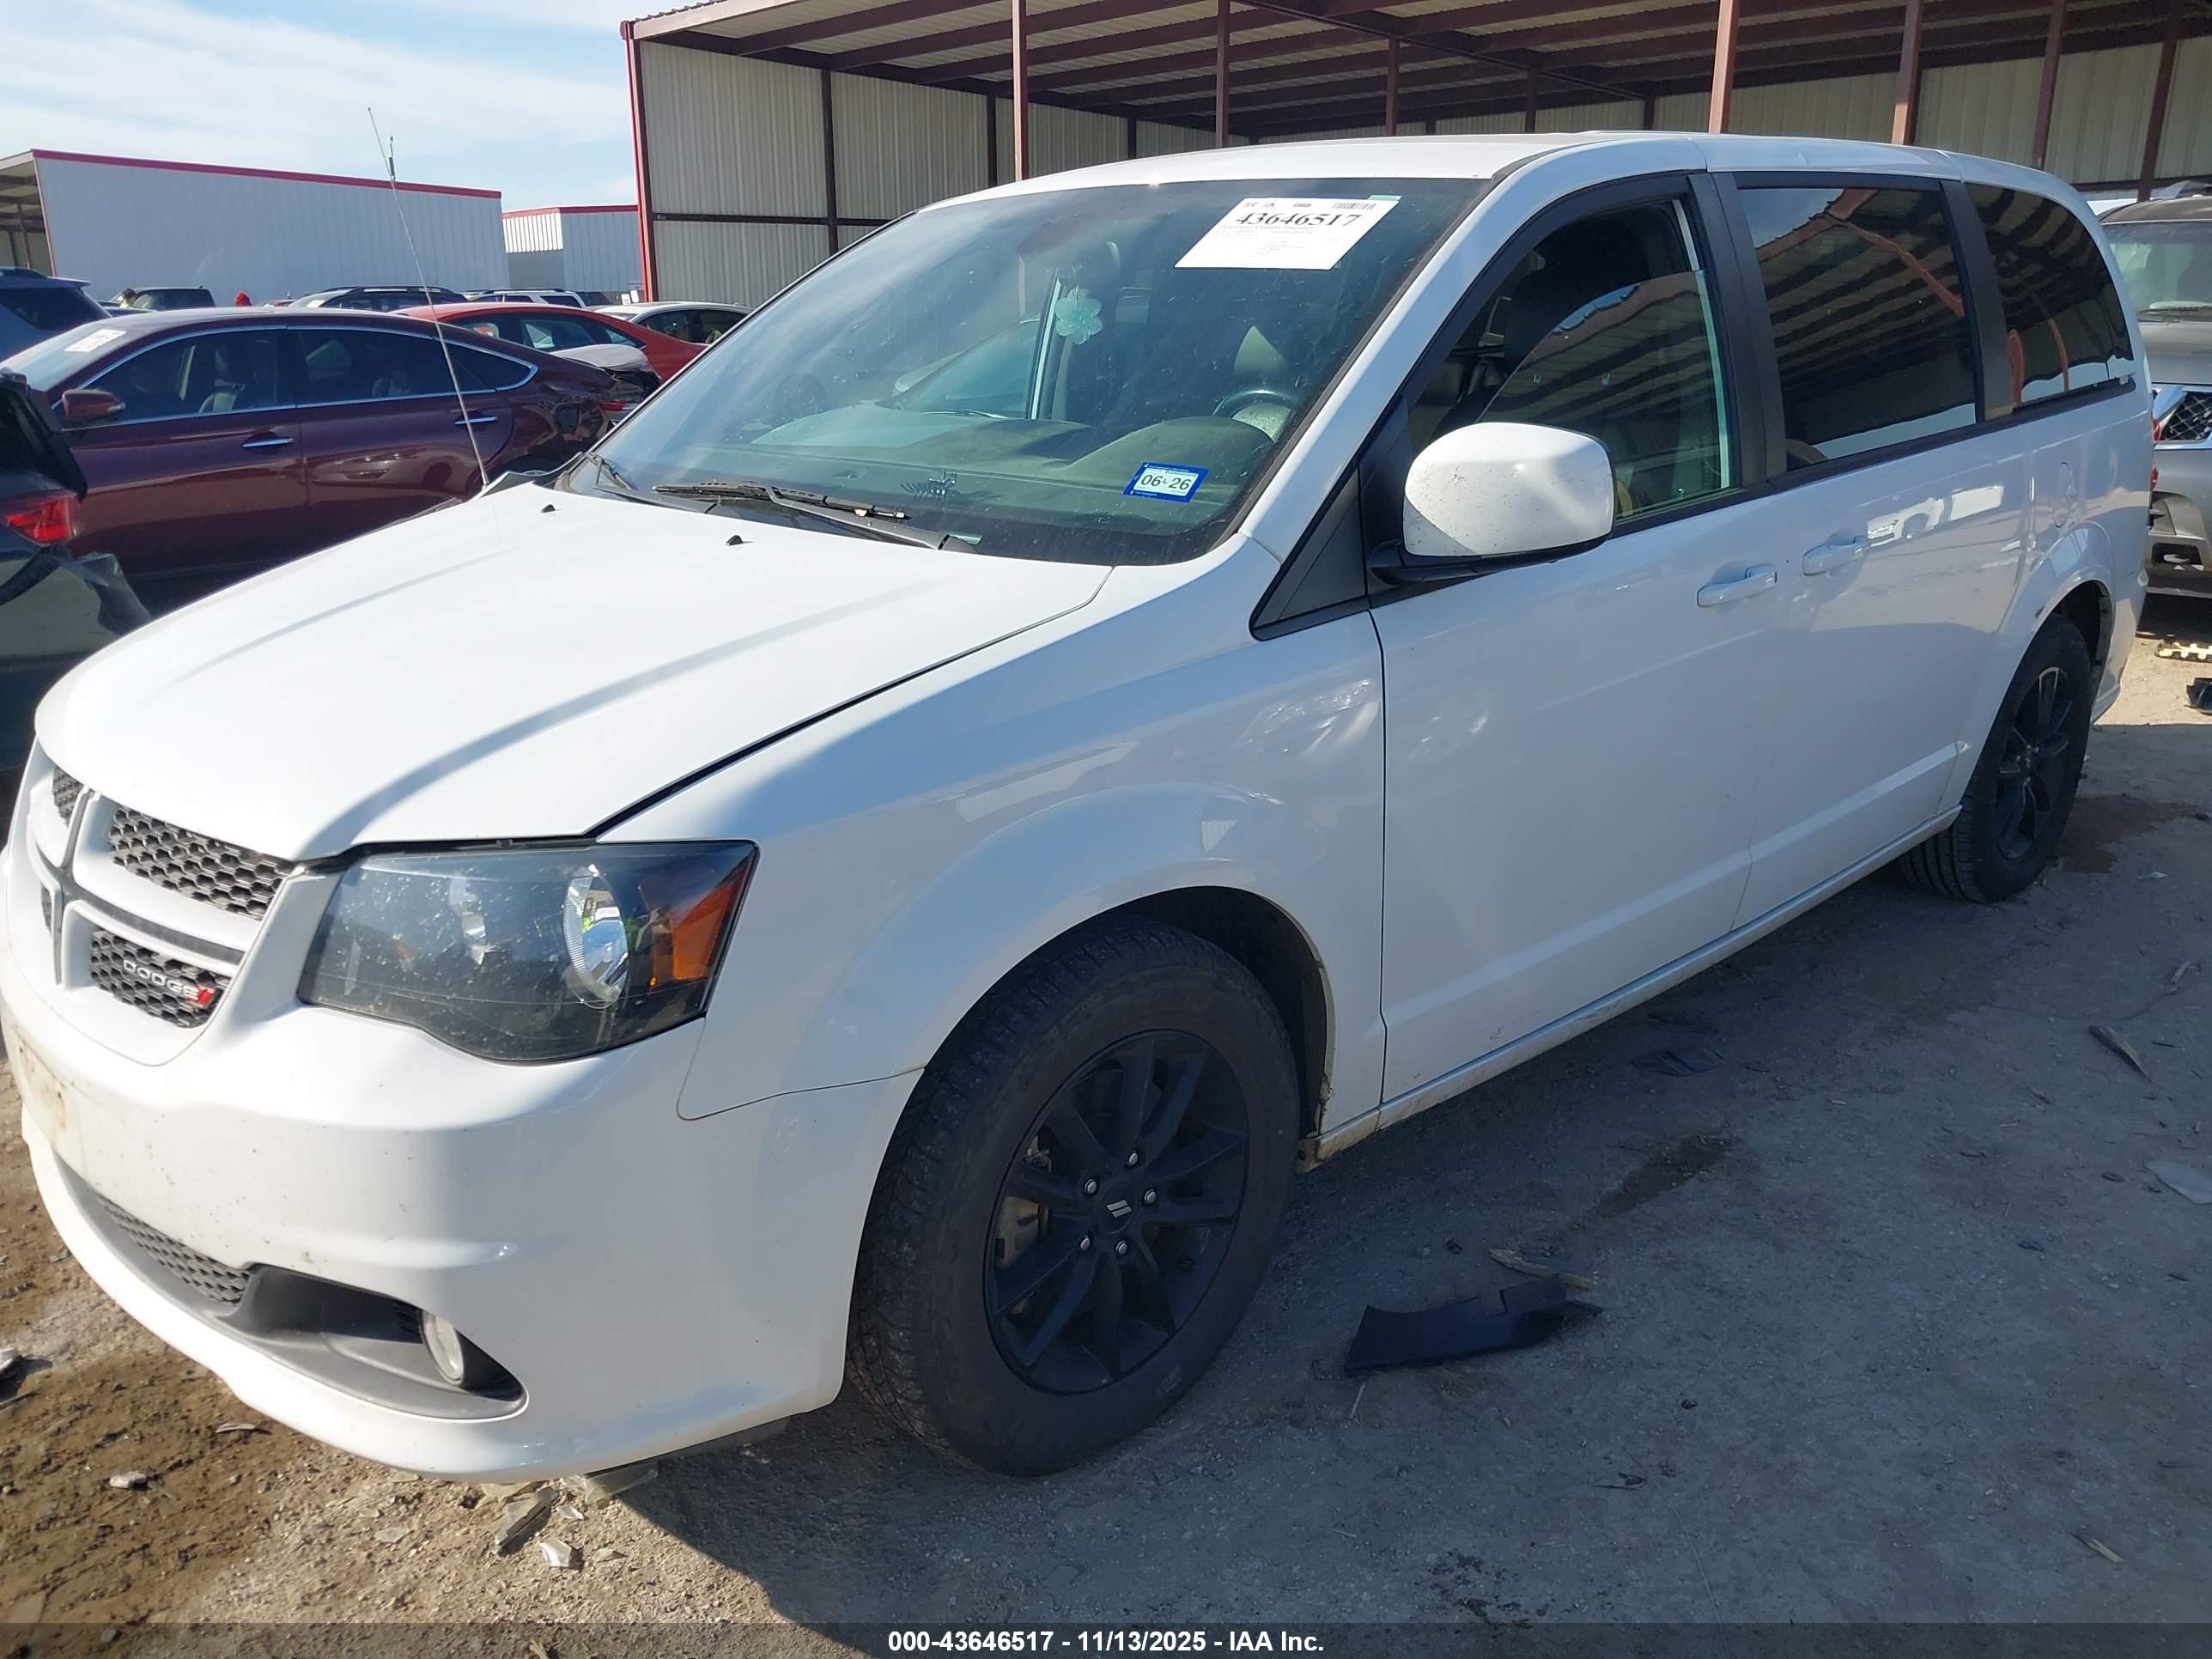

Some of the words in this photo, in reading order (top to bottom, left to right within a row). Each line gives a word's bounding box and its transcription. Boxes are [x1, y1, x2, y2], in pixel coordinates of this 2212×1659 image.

[1236, 212, 1363, 226] 43646517
[1141, 475, 1164, 486] 06
[1169, 477, 1192, 489] 26
[123, 959, 199, 1001] DODGE
